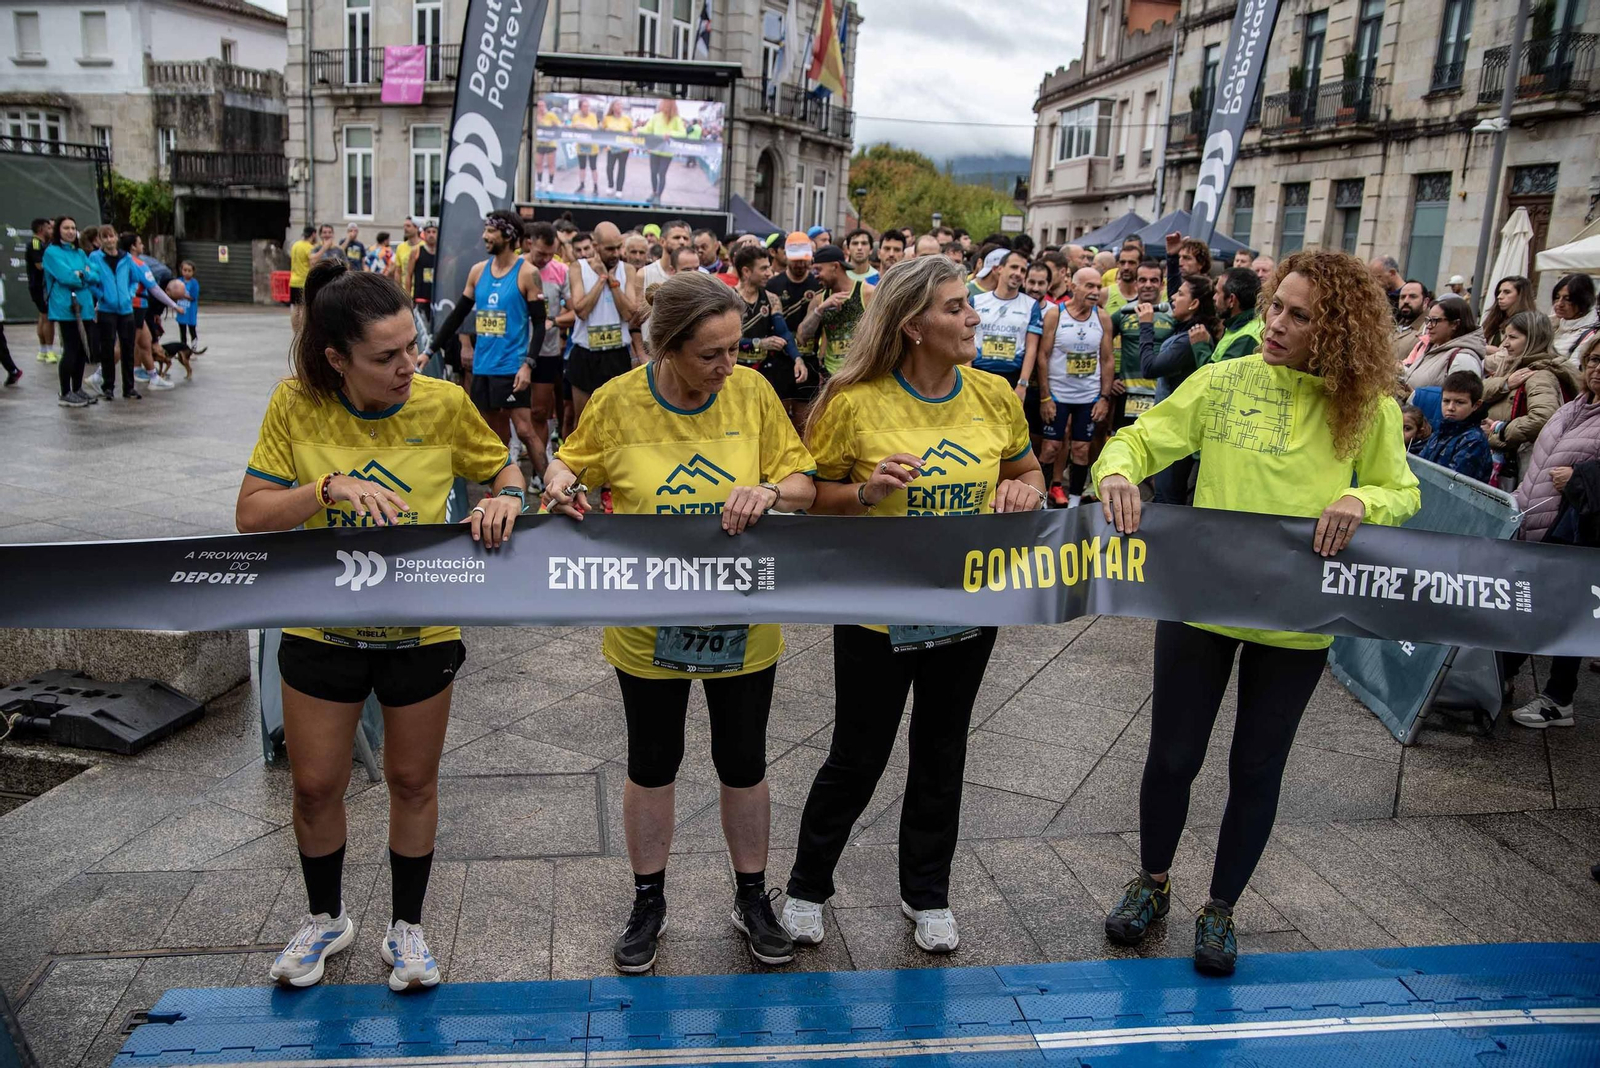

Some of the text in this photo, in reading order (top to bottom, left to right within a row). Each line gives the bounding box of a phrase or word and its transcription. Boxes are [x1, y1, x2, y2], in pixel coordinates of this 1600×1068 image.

[994, 343, 1004, 351] 15
[1135, 401, 1150, 410] 172
[907, 482, 977, 510] ENTRE
[184, 551, 268, 561] A PROVINCIA
[395, 556, 485, 573] Deputación
[963, 535, 1147, 593] GONDOMAR
[229, 561, 250, 571] DO
[548, 556, 752, 591] ENTRE PONTES
[757, 556, 767, 591] TRAIL &
[766, 556, 775, 591] RUNNING
[170, 571, 258, 585] DEPORTE
[394, 571, 485, 583] Pontevedra
[1321, 561, 1511, 610] ENTRE PONTES
[1516, 590, 1524, 612] TRAIL
[356, 629, 387, 638] XISELA
[682, 632, 725, 653] 770
